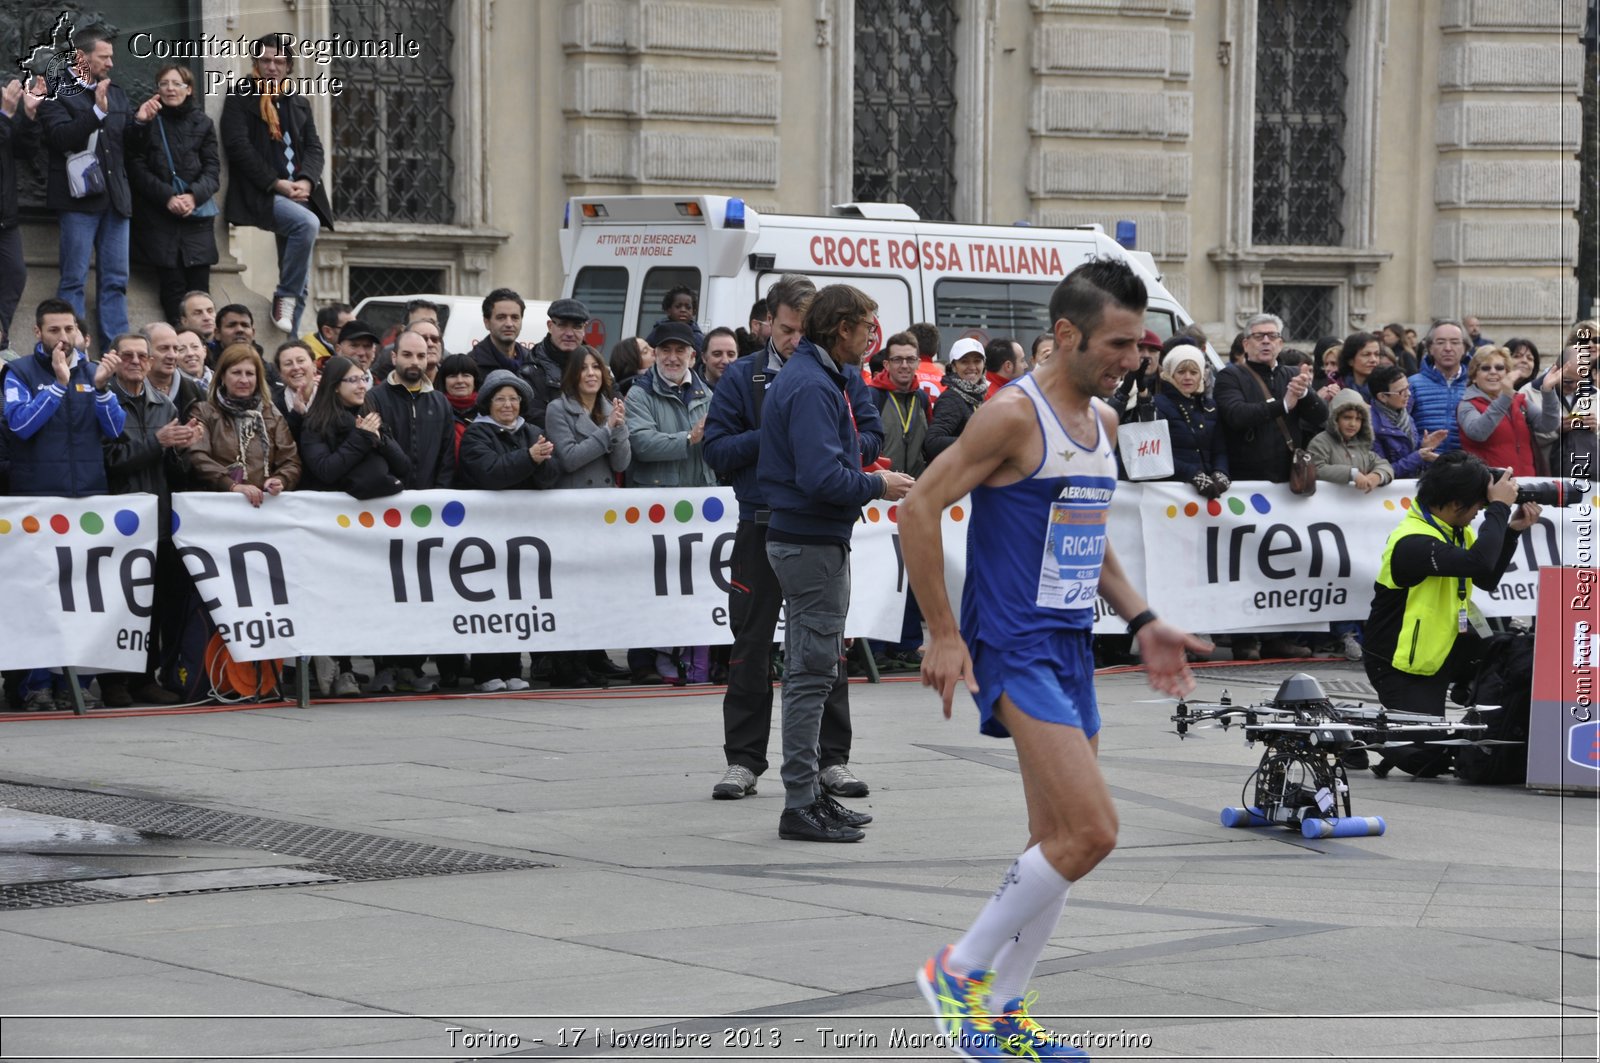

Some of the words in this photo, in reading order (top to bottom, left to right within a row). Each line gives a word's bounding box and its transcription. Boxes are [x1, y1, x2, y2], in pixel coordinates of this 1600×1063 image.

[632, 234, 641, 245] DI
[643, 234, 697, 245] EMERGENZA
[640, 246, 673, 256] MOBILE
[809, 235, 881, 268] CROCE
[888, 240, 963, 272] ROSSA
[968, 243, 1064, 276] ITALIANA
[1137, 438, 1161, 457] H&M
[1206, 521, 1351, 584] iren
[389, 536, 553, 603] iren
[1254, 582, 1348, 612] energia
[452, 606, 556, 640] energia
